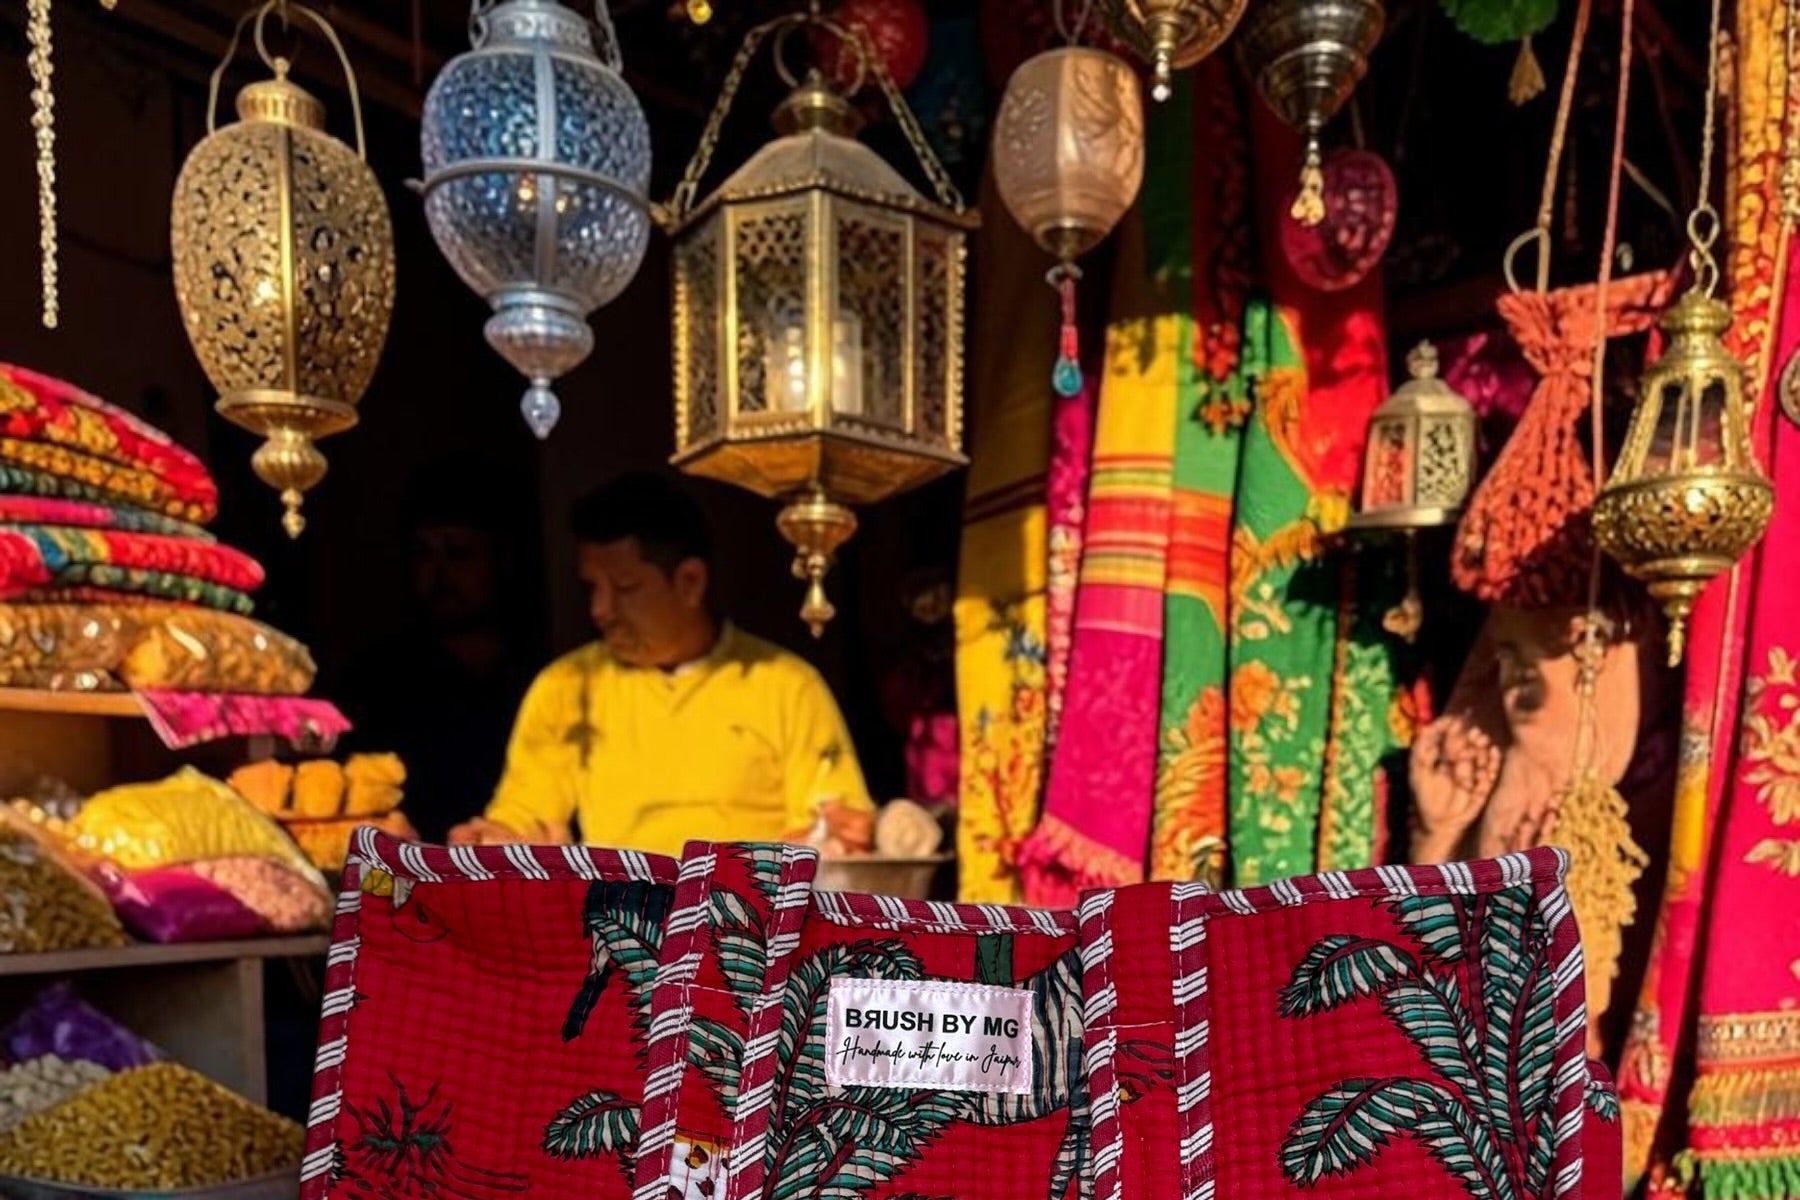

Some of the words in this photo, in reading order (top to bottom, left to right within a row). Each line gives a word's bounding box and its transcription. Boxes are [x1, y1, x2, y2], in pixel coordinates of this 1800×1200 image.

[942, 1014, 977, 1034] BY
[983, 1016, 1019, 1038] MG
[836, 1035, 905, 1065] Handmade
[908, 1041, 939, 1069] with
[936, 1042, 963, 1070] love
[965, 1052, 979, 1062] in
